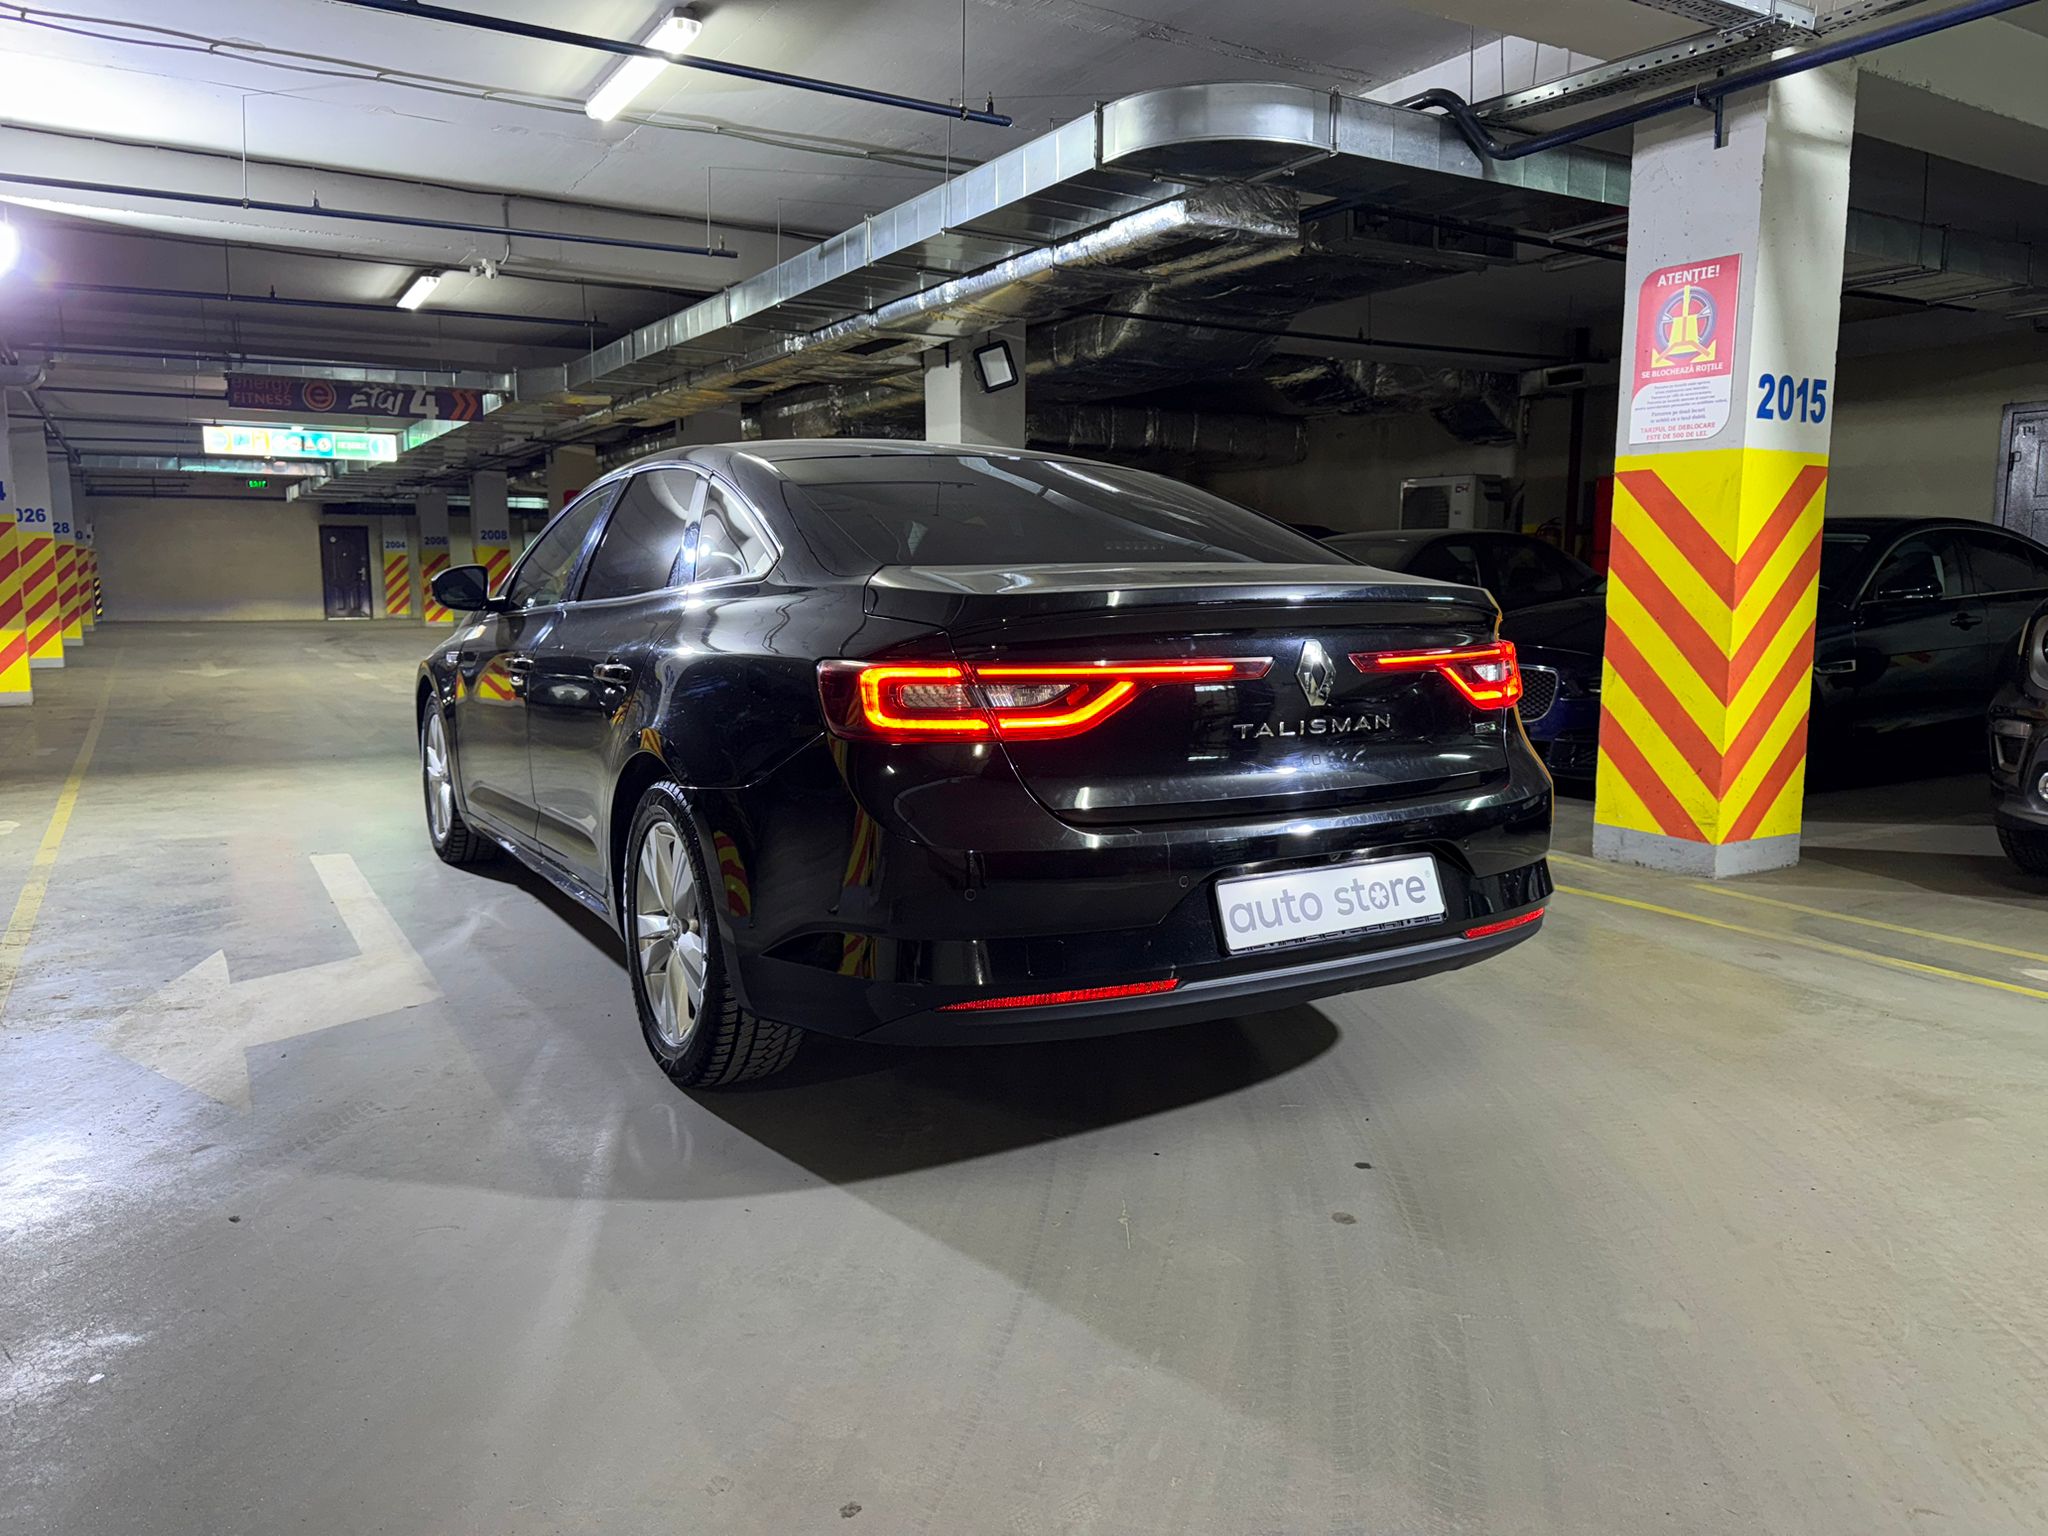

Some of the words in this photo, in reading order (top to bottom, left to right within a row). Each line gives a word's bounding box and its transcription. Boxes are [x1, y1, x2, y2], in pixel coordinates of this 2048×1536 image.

[1641, 370, 1651, 379] SE
[233, 391, 293, 407] FITNESS
[409, 386, 440, 419] 4
[1757, 373, 1827, 424] 2015
[1668, 424, 1677, 432] DE
[481, 529, 508, 541] 2008
[1233, 713, 1392, 740] TALISMAN
[1229, 888, 1324, 934] auto
[1334, 875, 1427, 916] store
